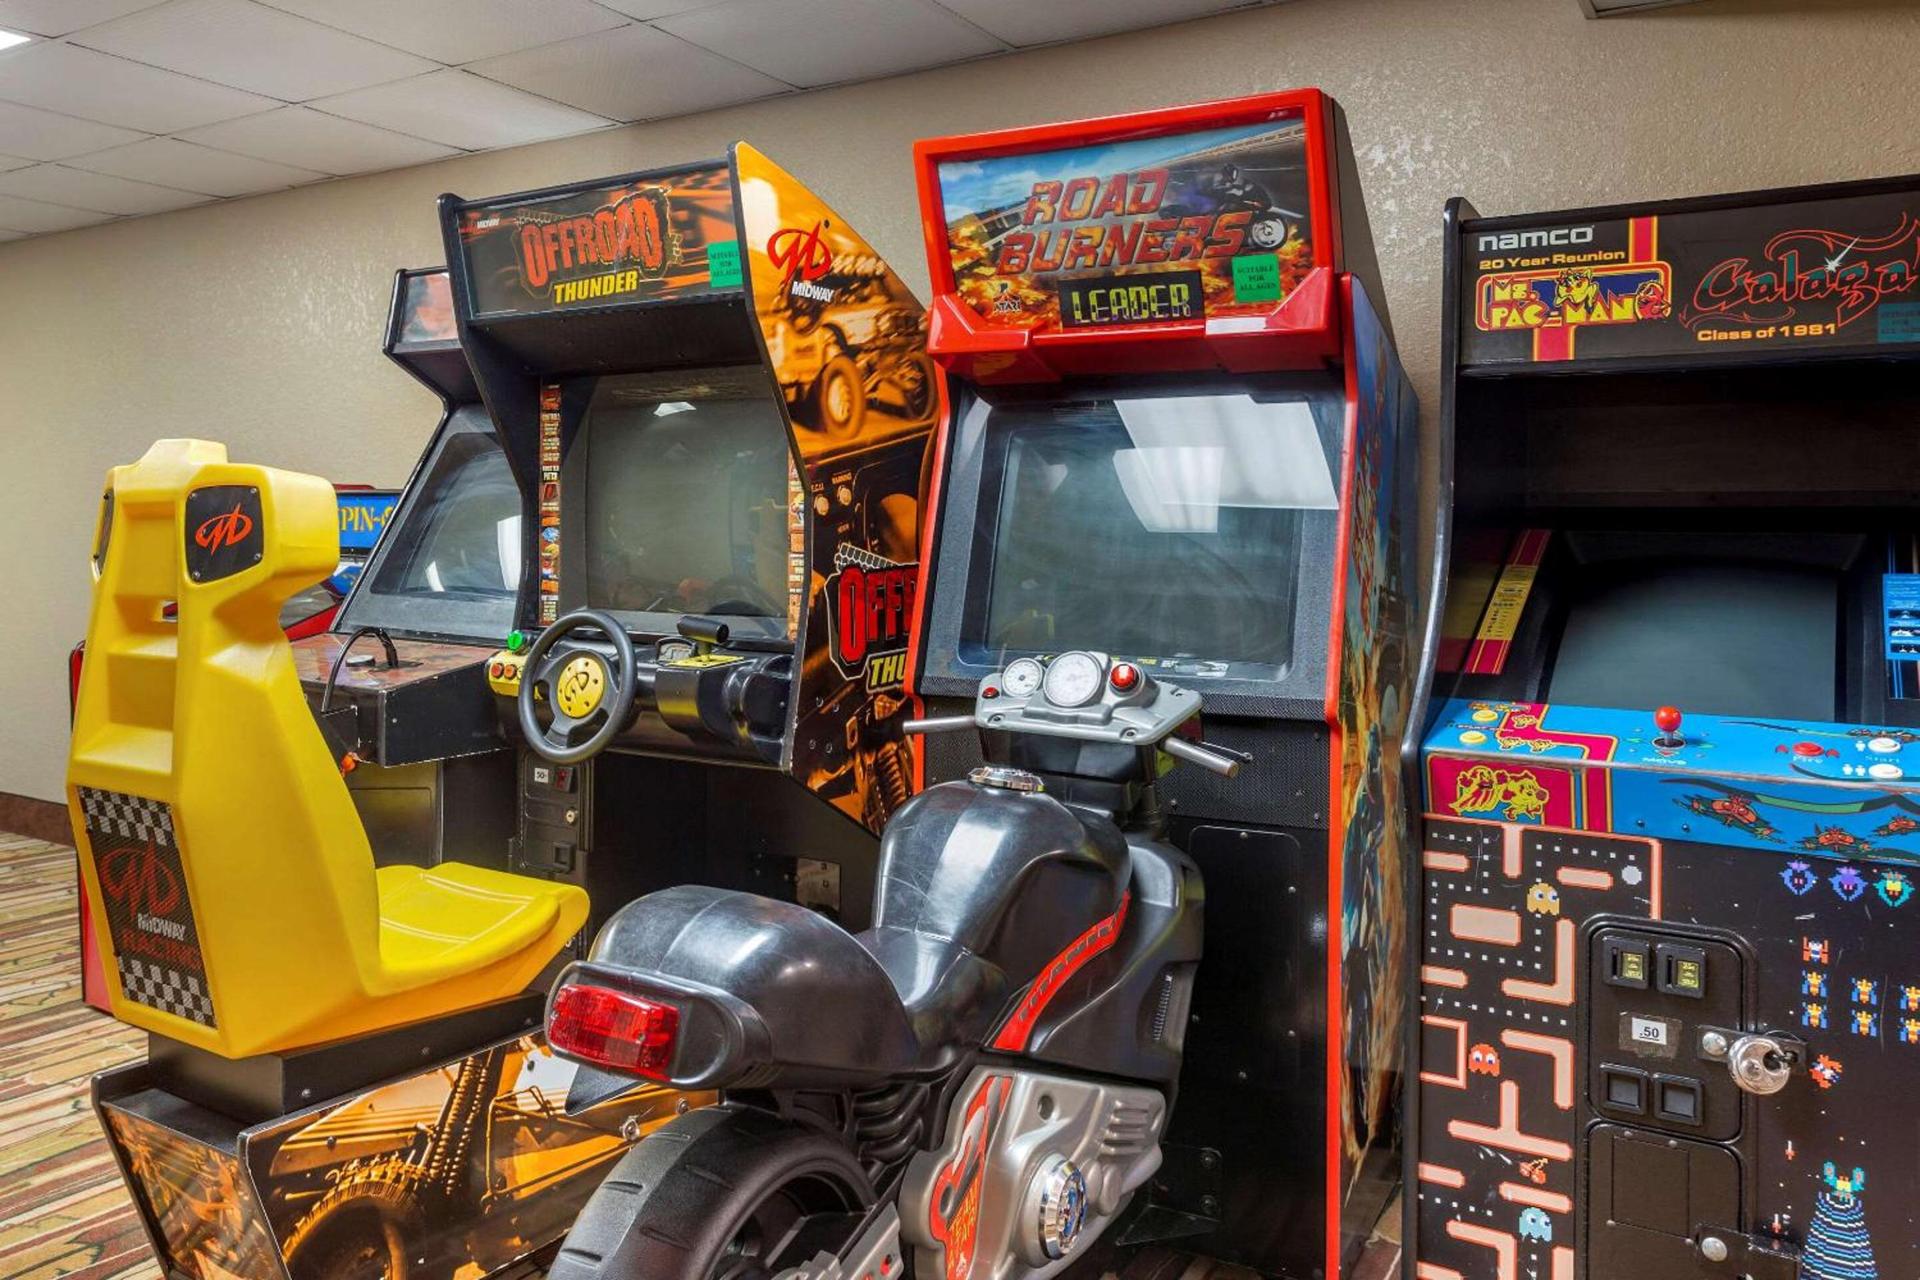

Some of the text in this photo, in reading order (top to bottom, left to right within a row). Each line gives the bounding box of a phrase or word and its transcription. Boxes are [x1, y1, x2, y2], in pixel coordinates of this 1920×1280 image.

[1023, 168, 1170, 226] ROAD
[520, 196, 664, 288] OFFROAD
[999, 211, 1255, 275] BURNERS
[1478, 226, 1593, 252] namco
[1479, 251, 1626, 270] 20 Year Reunion
[552, 270, 639, 304] THUNDER
[791, 280, 835, 303] MIDWAY
[1248, 274, 1265, 282] FOR
[1693, 246, 1920, 328] Galaga
[993, 299, 1023, 313] ATARI
[1071, 283, 1192, 324] LEADER
[1490, 295, 1634, 330] PAC-MAN
[1697, 323, 1838, 341] Class of 1981
[137, 913, 187, 941] MIDWAY
[1639, 1025, 1660, 1039] .50
